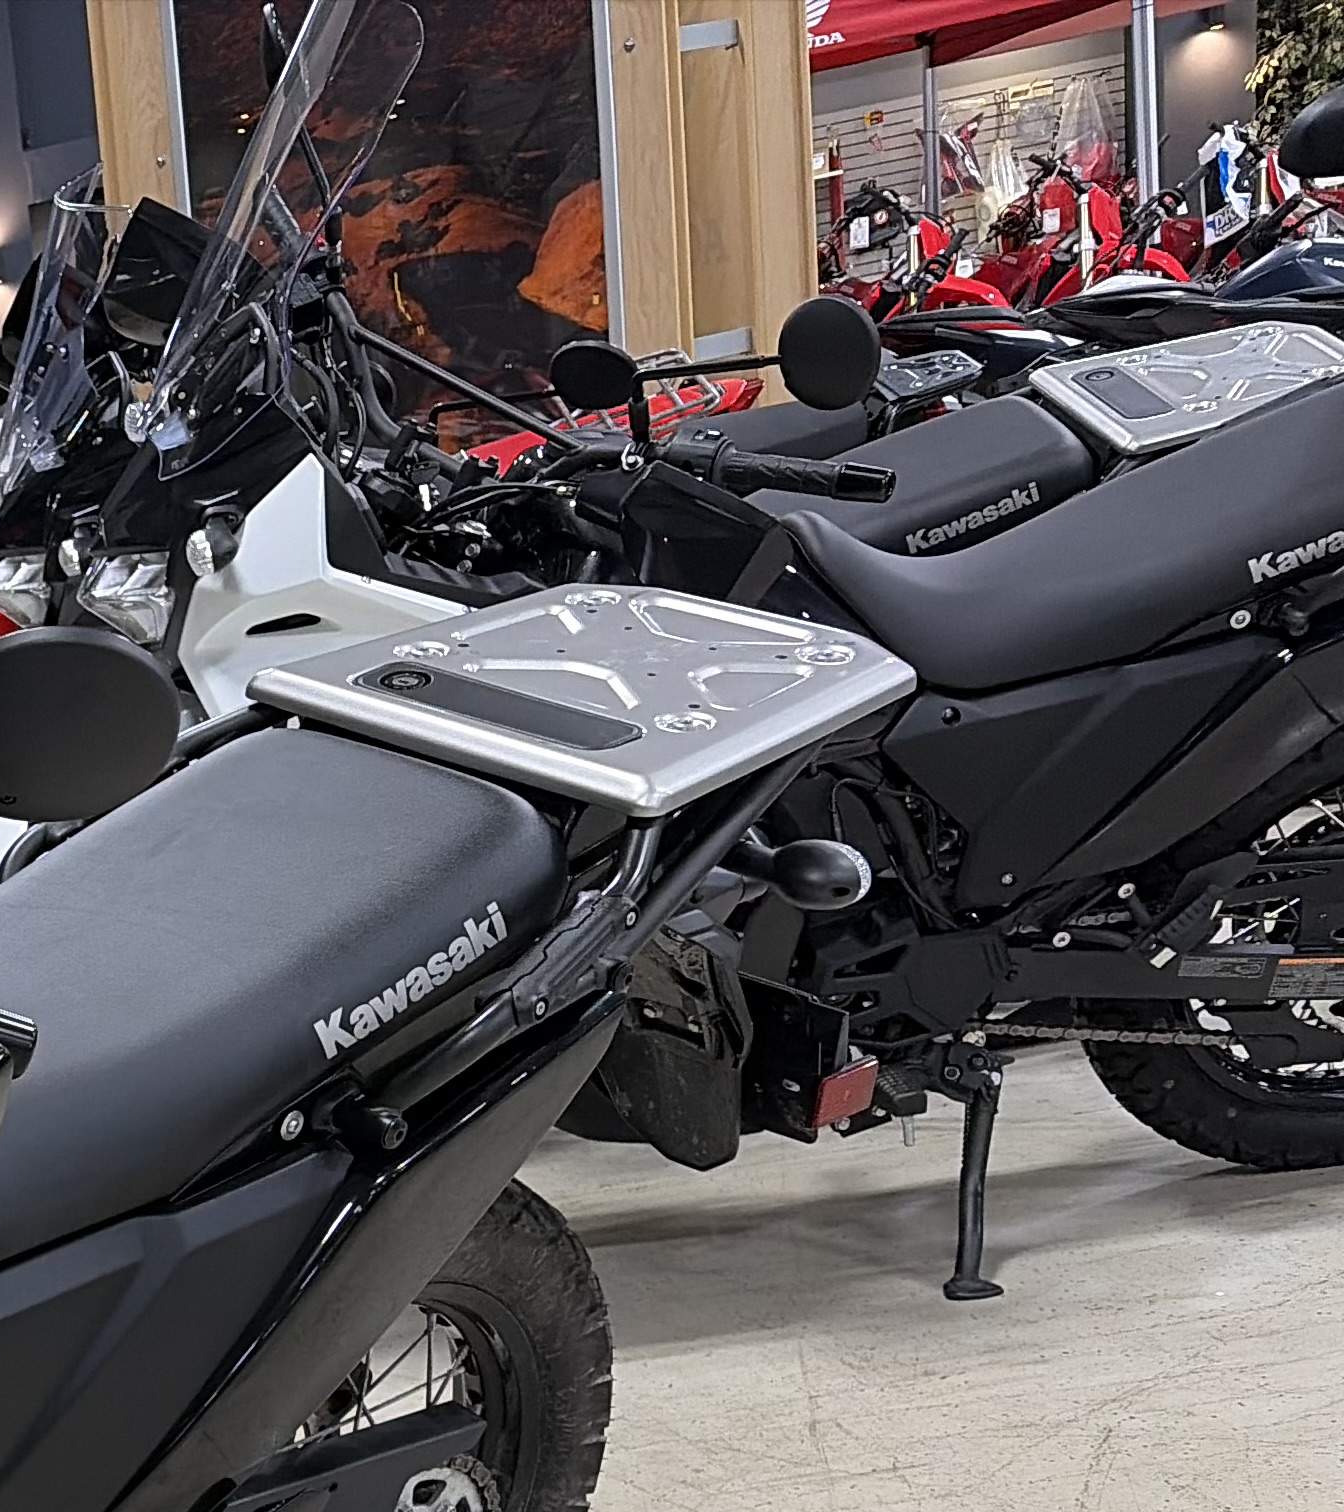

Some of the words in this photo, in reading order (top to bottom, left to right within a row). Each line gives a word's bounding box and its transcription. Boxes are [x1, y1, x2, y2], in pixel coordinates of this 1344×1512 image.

[905, 481, 1040, 554] Kawasaki
[1247, 530, 1344, 584] Kawa
[313, 901, 507, 1060] Kawasaki
